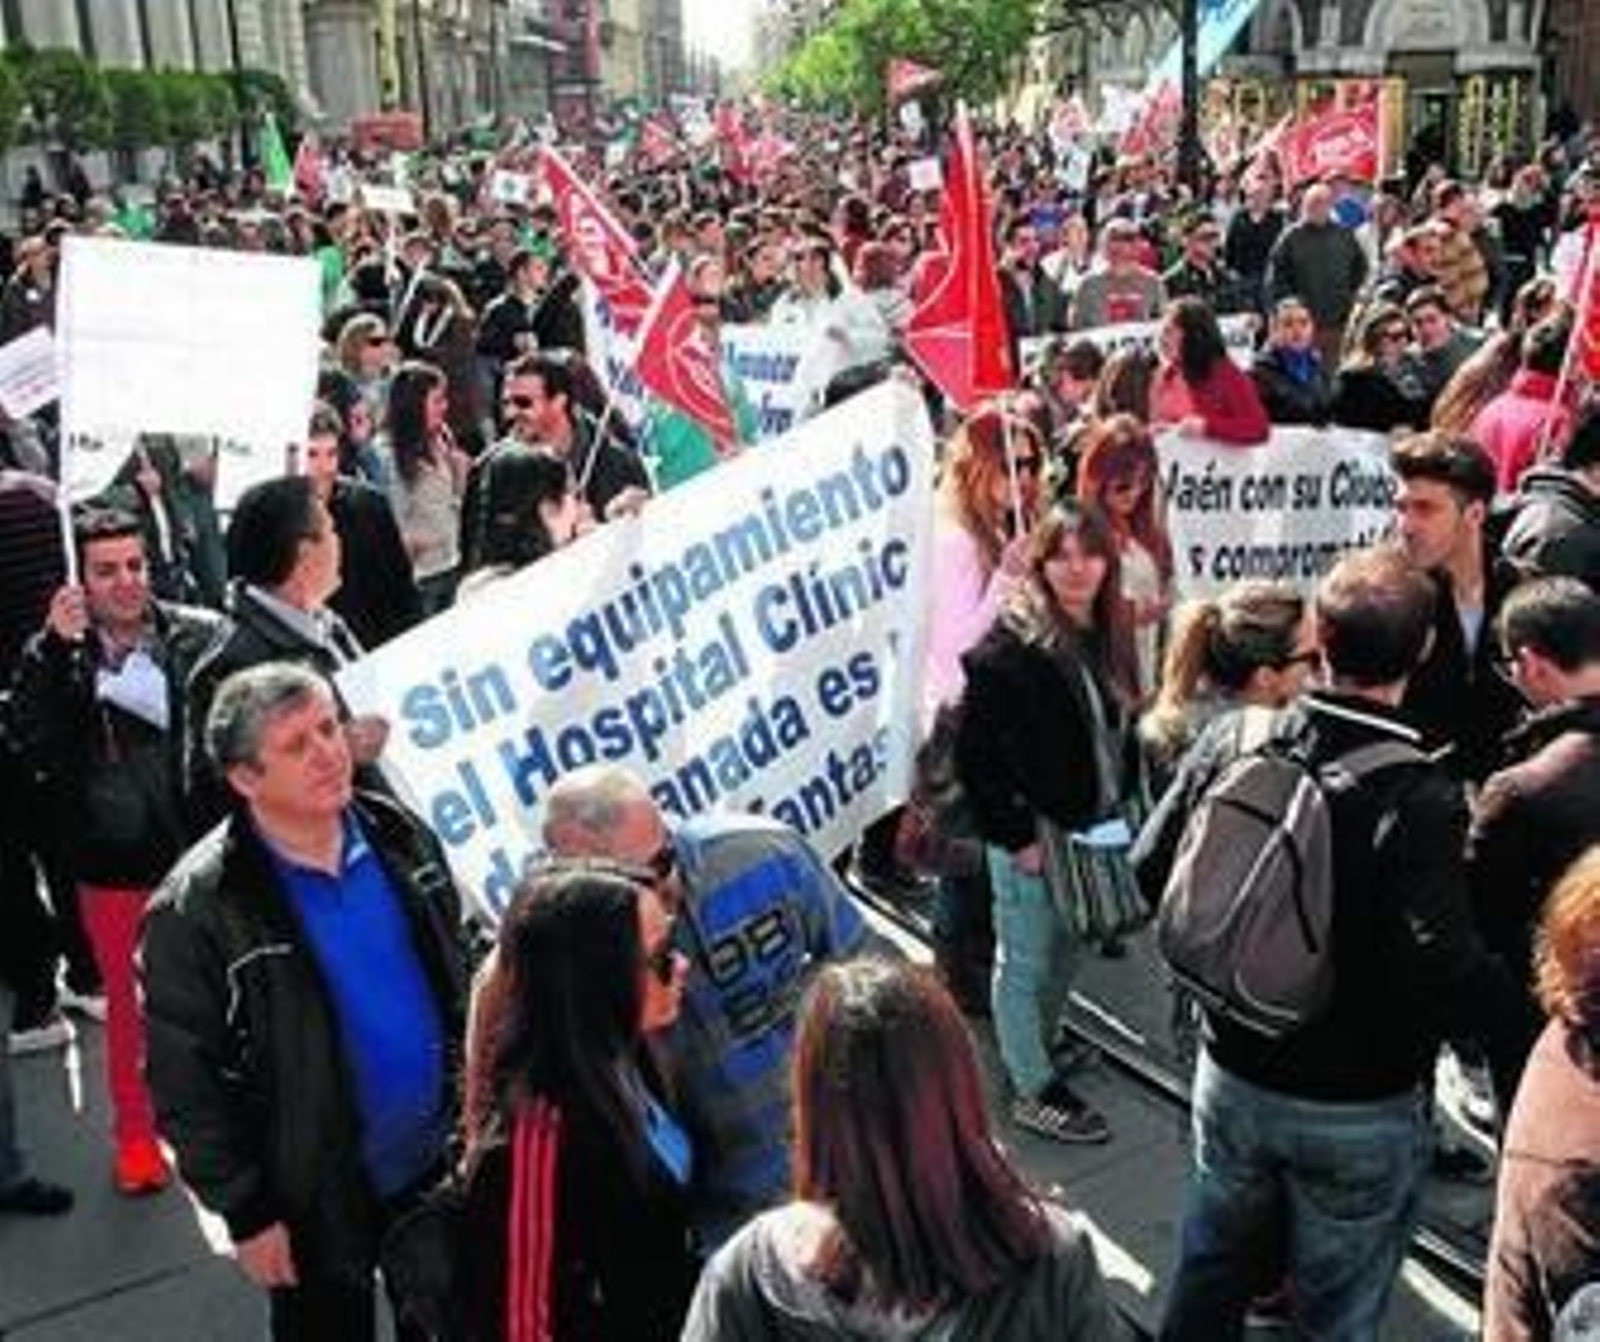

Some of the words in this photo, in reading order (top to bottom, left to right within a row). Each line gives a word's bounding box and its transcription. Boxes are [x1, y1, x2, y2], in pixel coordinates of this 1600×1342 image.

[404, 666, 515, 749] Sin
[532, 446, 909, 689] equipamiento
[1240, 474, 1287, 512] con
[1292, 473, 1323, 512] su
[432, 760, 496, 851] el
[501, 612, 750, 806] Hospital
[758, 538, 909, 655] Clínic
[652, 678, 811, 820] anada
[818, 650, 881, 718] es
